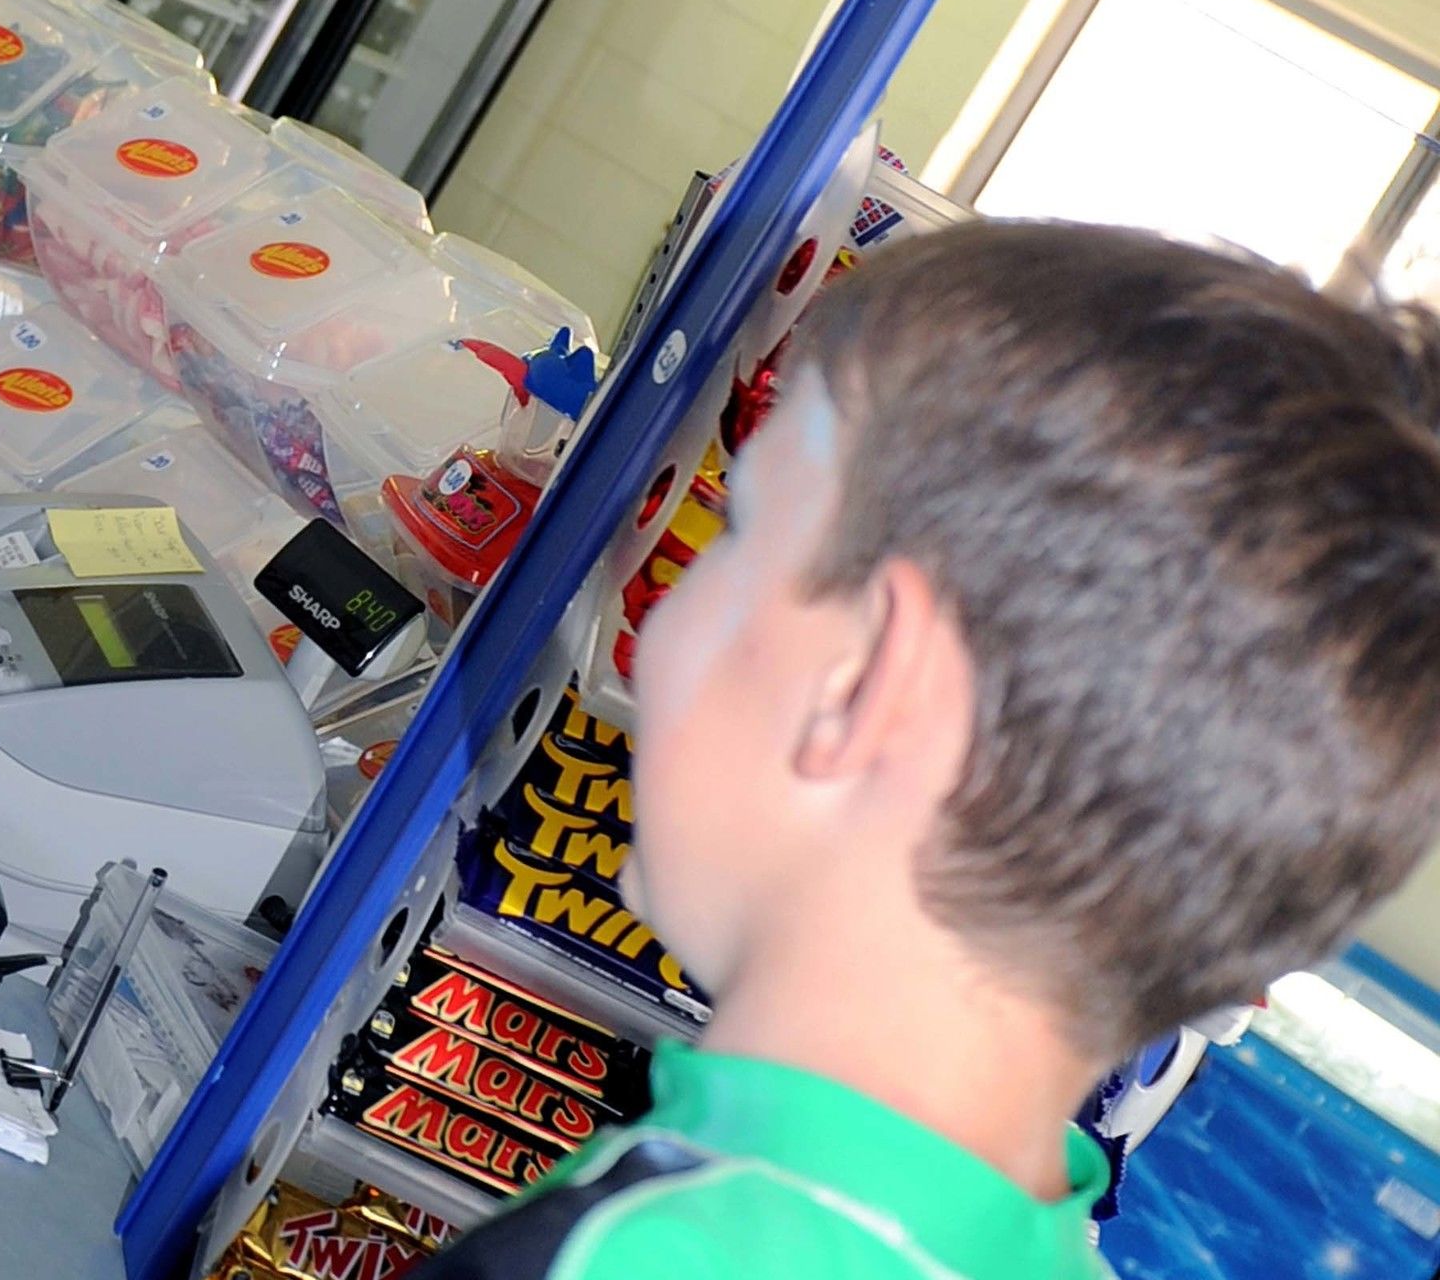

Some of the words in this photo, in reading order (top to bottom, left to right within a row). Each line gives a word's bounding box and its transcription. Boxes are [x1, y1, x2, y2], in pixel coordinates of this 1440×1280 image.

[288, 584, 341, 630] SHARP
[411, 971, 608, 1080] Mars
[392, 1026, 595, 1139] Mars
